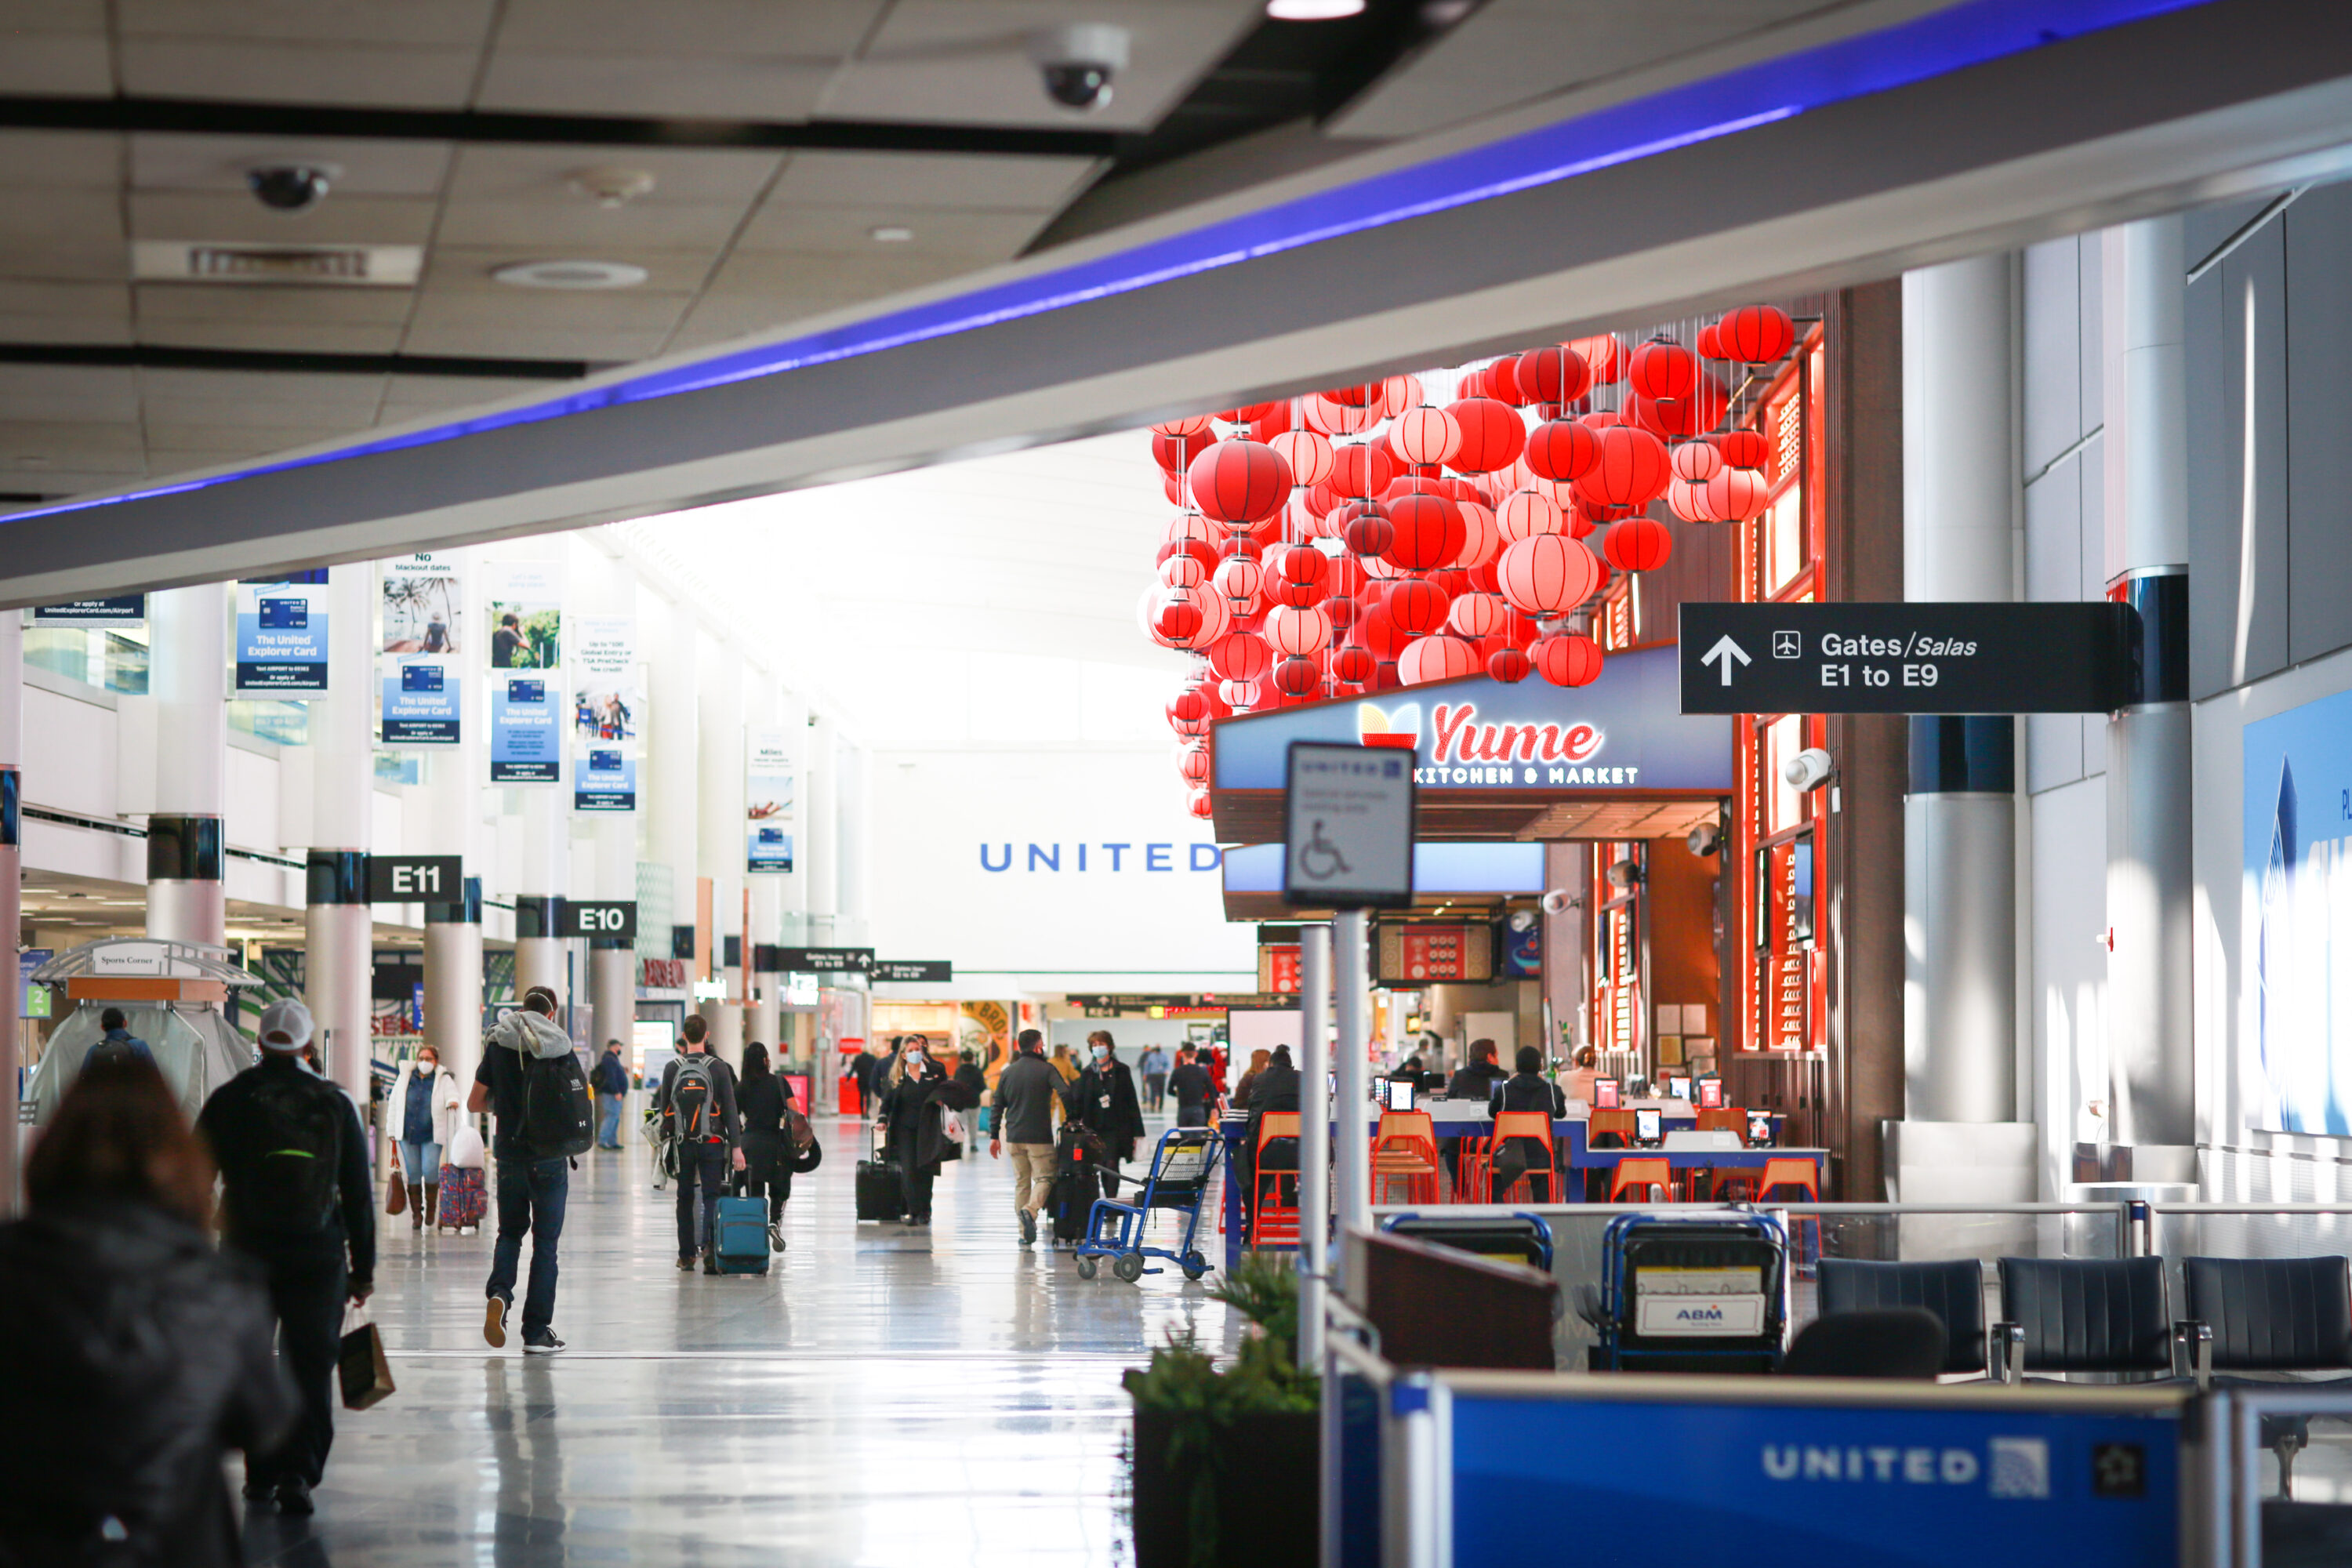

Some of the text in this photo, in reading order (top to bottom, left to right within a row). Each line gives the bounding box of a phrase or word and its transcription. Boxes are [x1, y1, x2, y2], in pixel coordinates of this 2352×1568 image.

[415, 553, 431, 562] No
[256, 634, 311, 645] The United
[247, 646, 318, 658] Explorer Card
[1820, 664, 1939, 687] E1 to E9
[399, 696, 448, 706] The United
[391, 706, 452, 717] Explorer Card
[1432, 704, 1603, 764] Yume
[1414, 767, 1639, 784] KITCHEN & MARKET
[979, 843, 1221, 873] UNITED
[392, 866, 440, 893] E11
[579, 908, 624, 931] E10
[101, 956, 125, 965] Sports
[34, 989, 44, 1004] 2
[1676, 1309, 1722, 1320] ABM
[1762, 1444, 1980, 1484] UNITED
